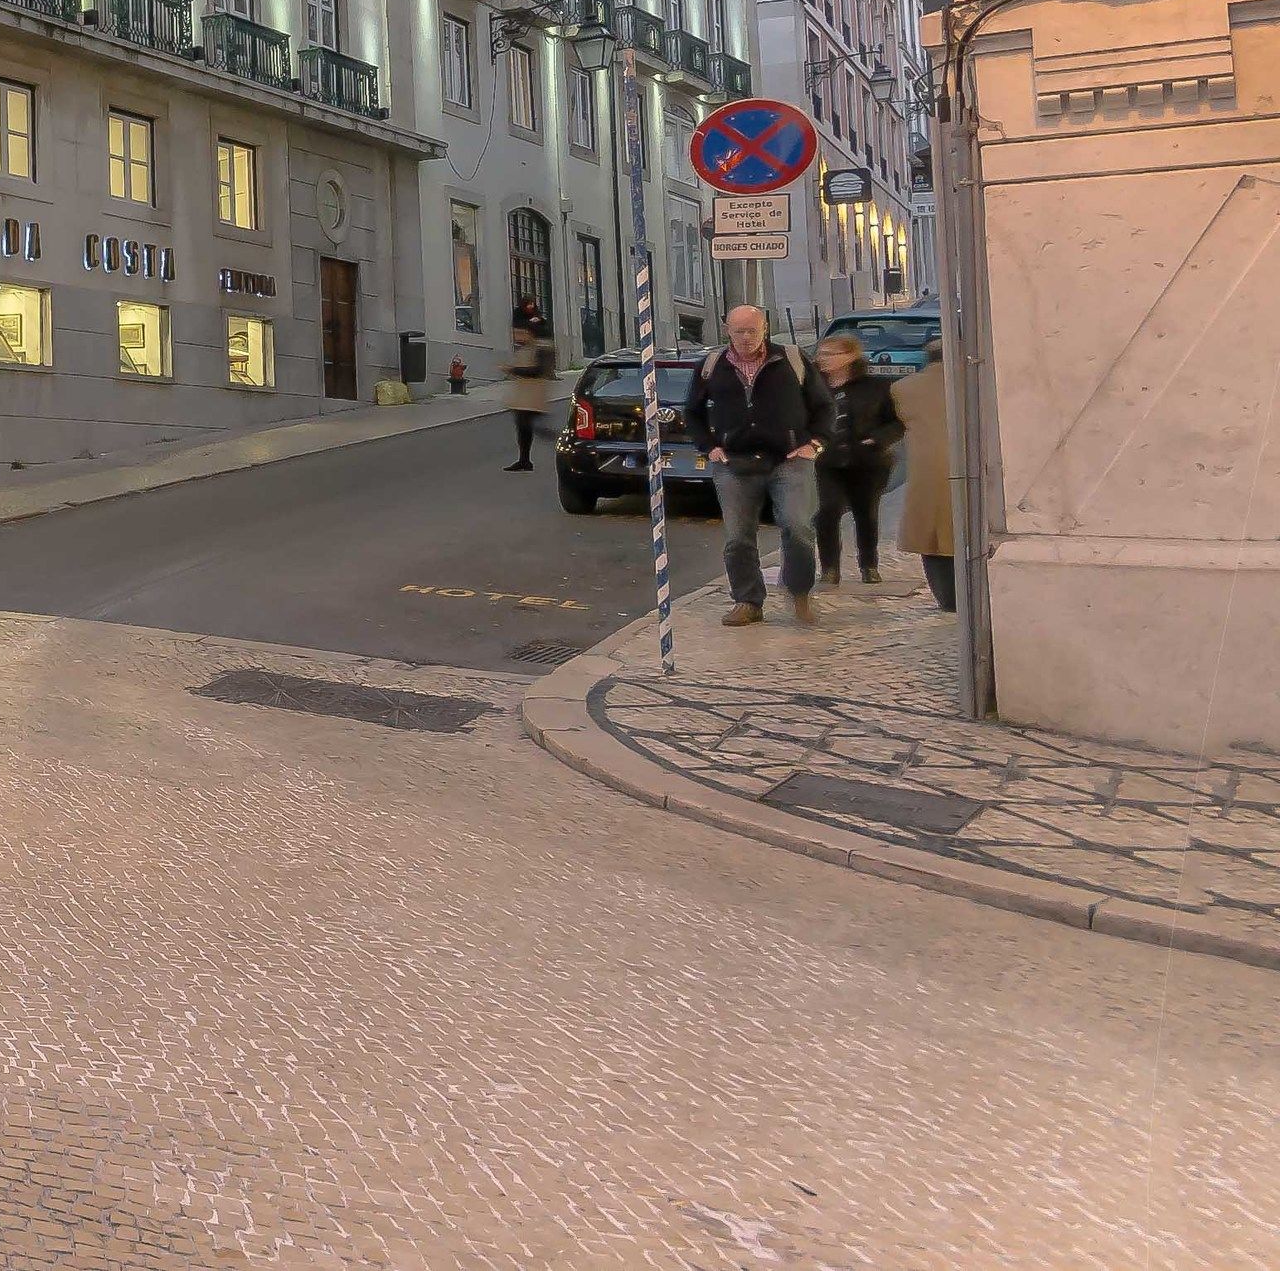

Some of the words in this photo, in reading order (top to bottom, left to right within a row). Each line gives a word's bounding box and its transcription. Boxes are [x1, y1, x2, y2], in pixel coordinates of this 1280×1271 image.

[729, 200, 773, 209] Excepto
[721, 211, 761, 220] Serviço
[769, 209, 782, 218] de
[736, 220, 767, 229] Hotel
[1, 218, 40, 262] DA
[82, 233, 176, 283] COSTA
[750, 242, 785, 251] CHIADO
[399, 584, 591, 610] HOTEL
